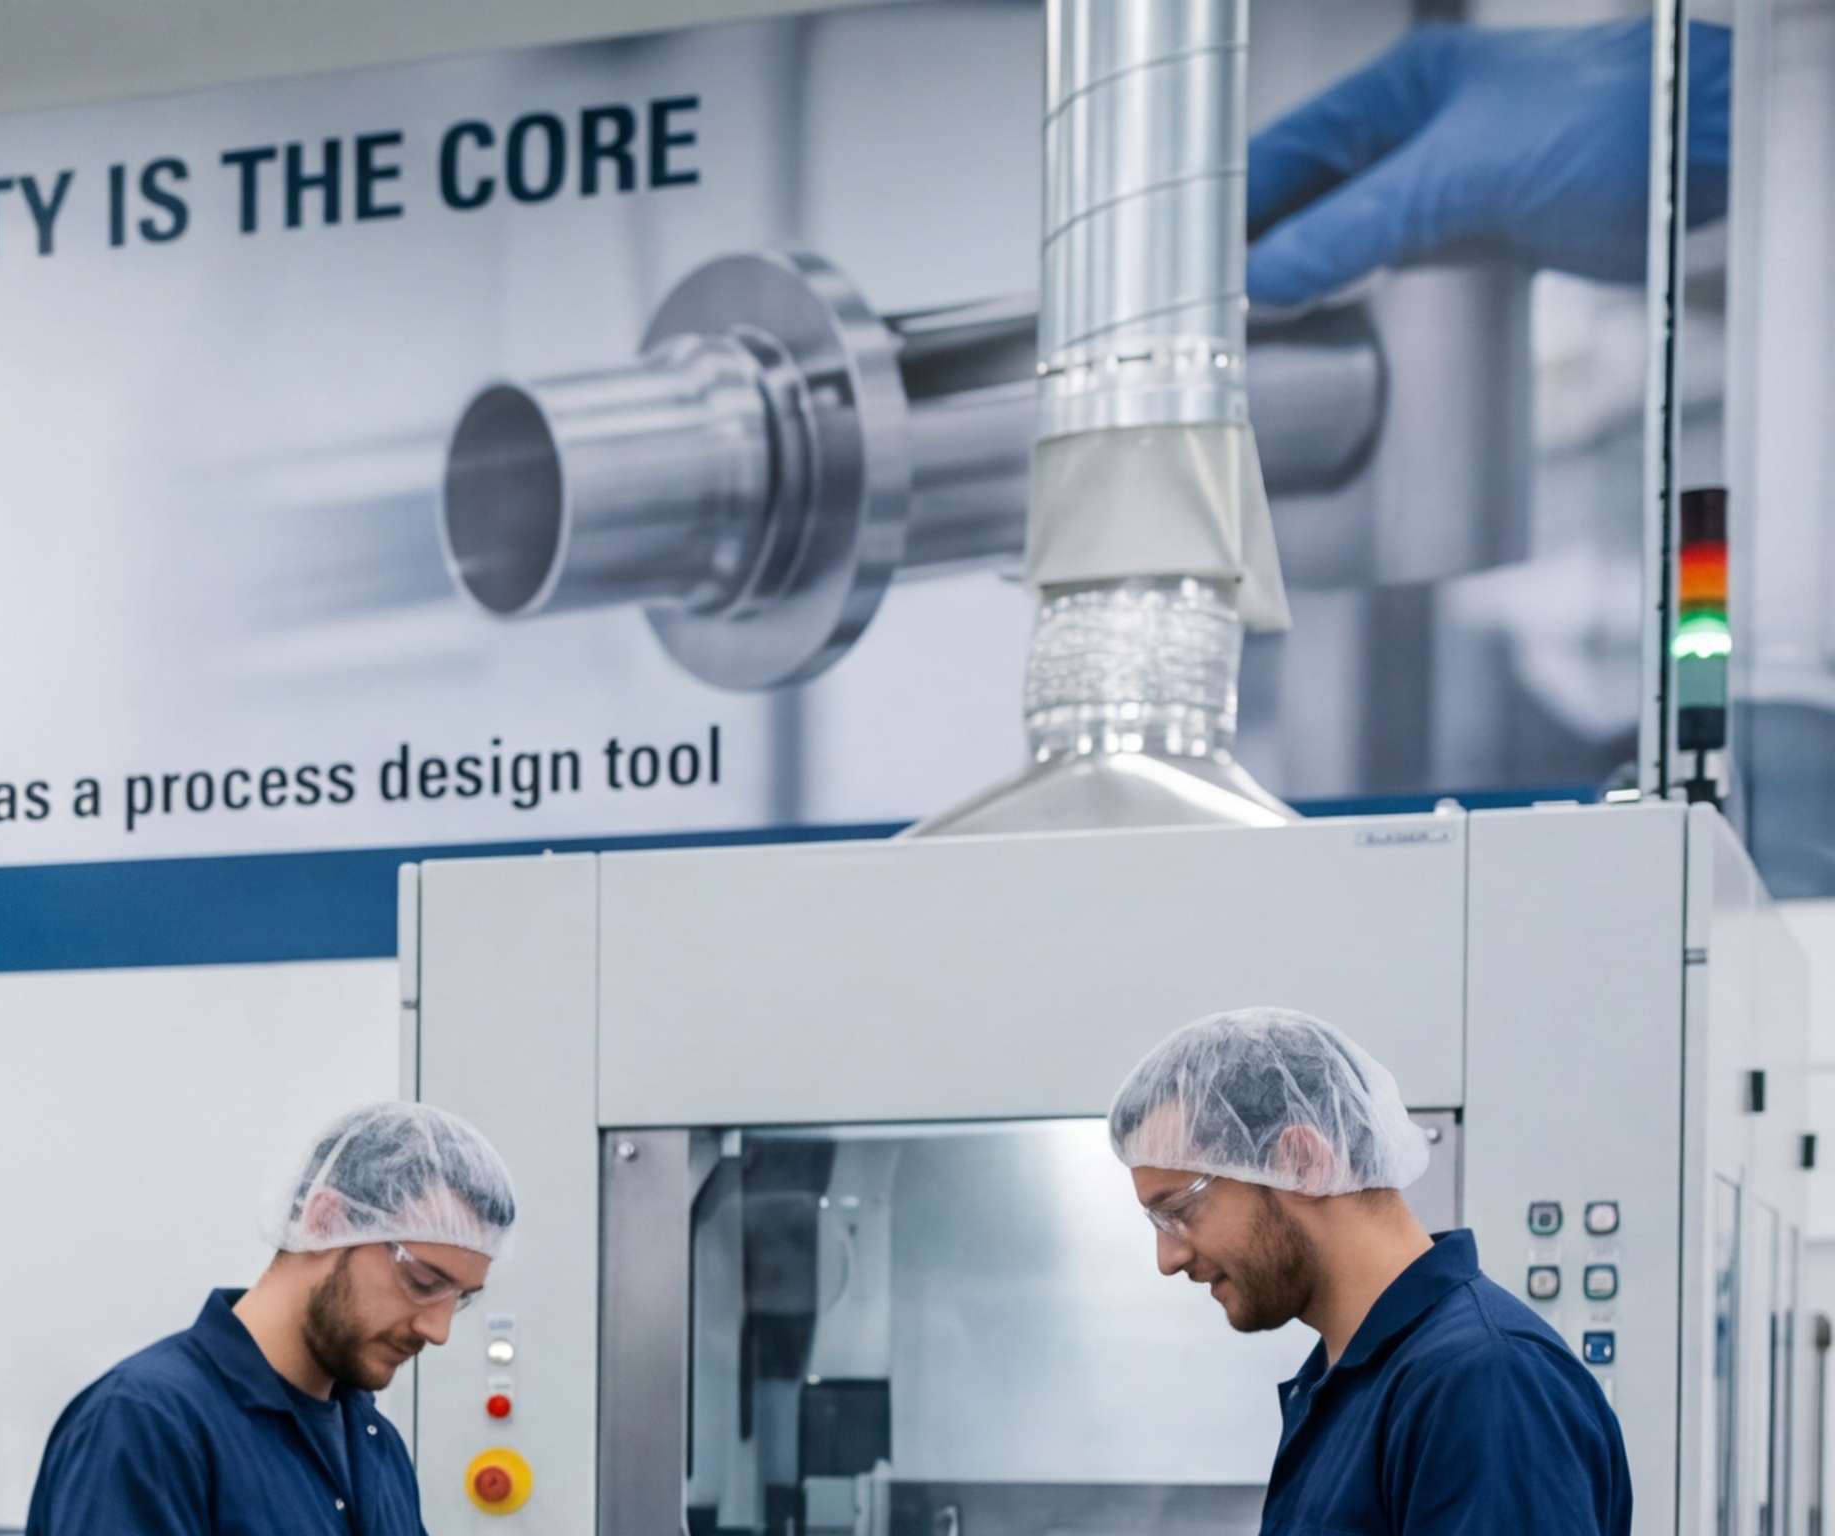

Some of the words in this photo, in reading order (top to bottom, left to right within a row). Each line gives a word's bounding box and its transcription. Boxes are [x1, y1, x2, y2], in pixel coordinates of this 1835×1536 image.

[109, 157, 190, 247] IS
[221, 131, 403, 235] THE
[439, 95, 701, 212] CORE
[73, 777, 102, 819] a
[126, 762, 355, 831] process
[380, 738, 580, 808] design
[604, 725, 721, 789] tool
